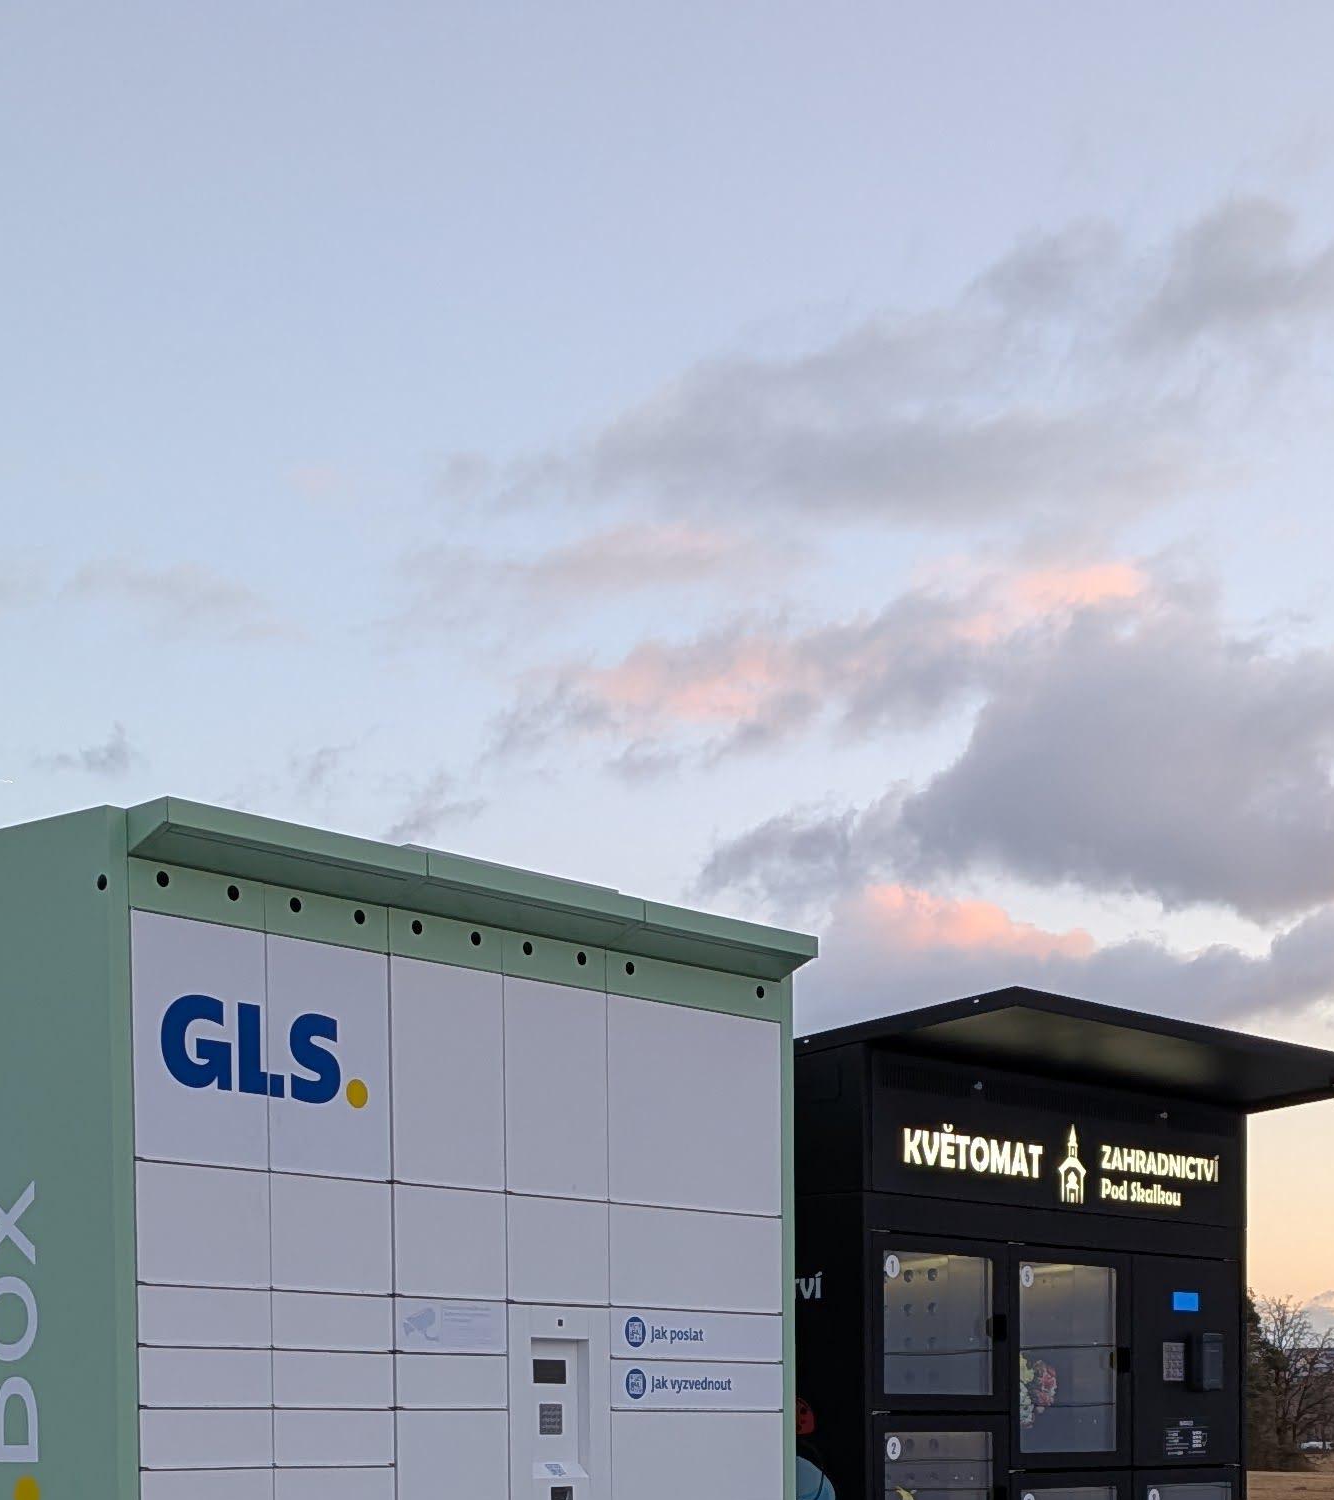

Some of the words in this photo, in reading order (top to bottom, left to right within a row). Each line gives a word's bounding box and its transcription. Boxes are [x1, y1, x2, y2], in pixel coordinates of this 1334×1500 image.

[903, 1123, 1044, 1179] KVĚTOMAT
[1100, 1144, 1220, 1183] ZAHRADNICTVÍ
[1101, 1177, 1128, 1201] Pod
[1130, 1181, 1182, 1207] Skalkou
[650, 1325, 668, 1344] Jak
[670, 1327, 704, 1344] poslat
[650, 1375, 668, 1393] Jak
[670, 1376, 732, 1394] vyzvednout
